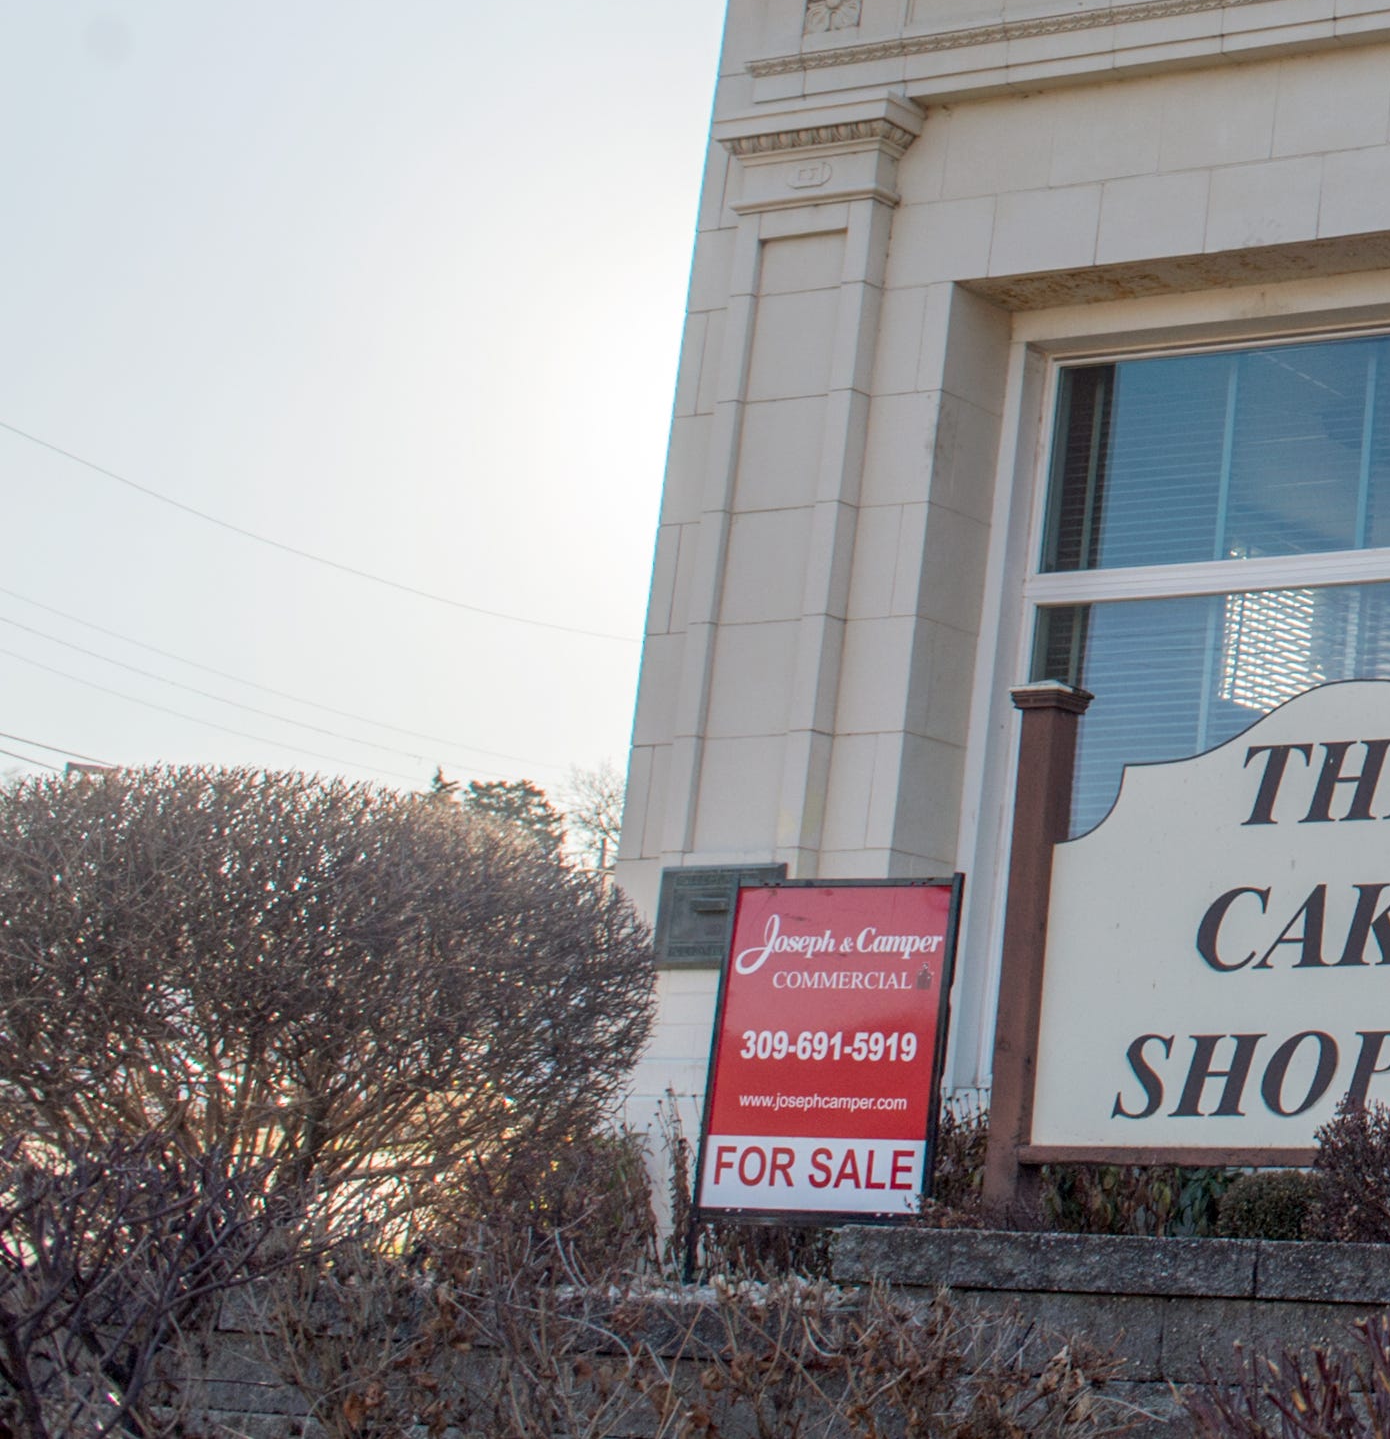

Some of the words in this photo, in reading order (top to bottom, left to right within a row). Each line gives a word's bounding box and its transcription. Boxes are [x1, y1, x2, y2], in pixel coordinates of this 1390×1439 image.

[735, 914, 836, 975] Joseph
[839, 936, 854, 952] &
[856, 927, 943, 959] Camper
[772, 971, 912, 989] COMMERCIAL
[740, 1029, 918, 1062] 309-691-5919
[739, 1092, 908, 1113] www.josephcamper.com
[713, 1145, 796, 1187] FOR
[808, 1147, 916, 1191] SALE
